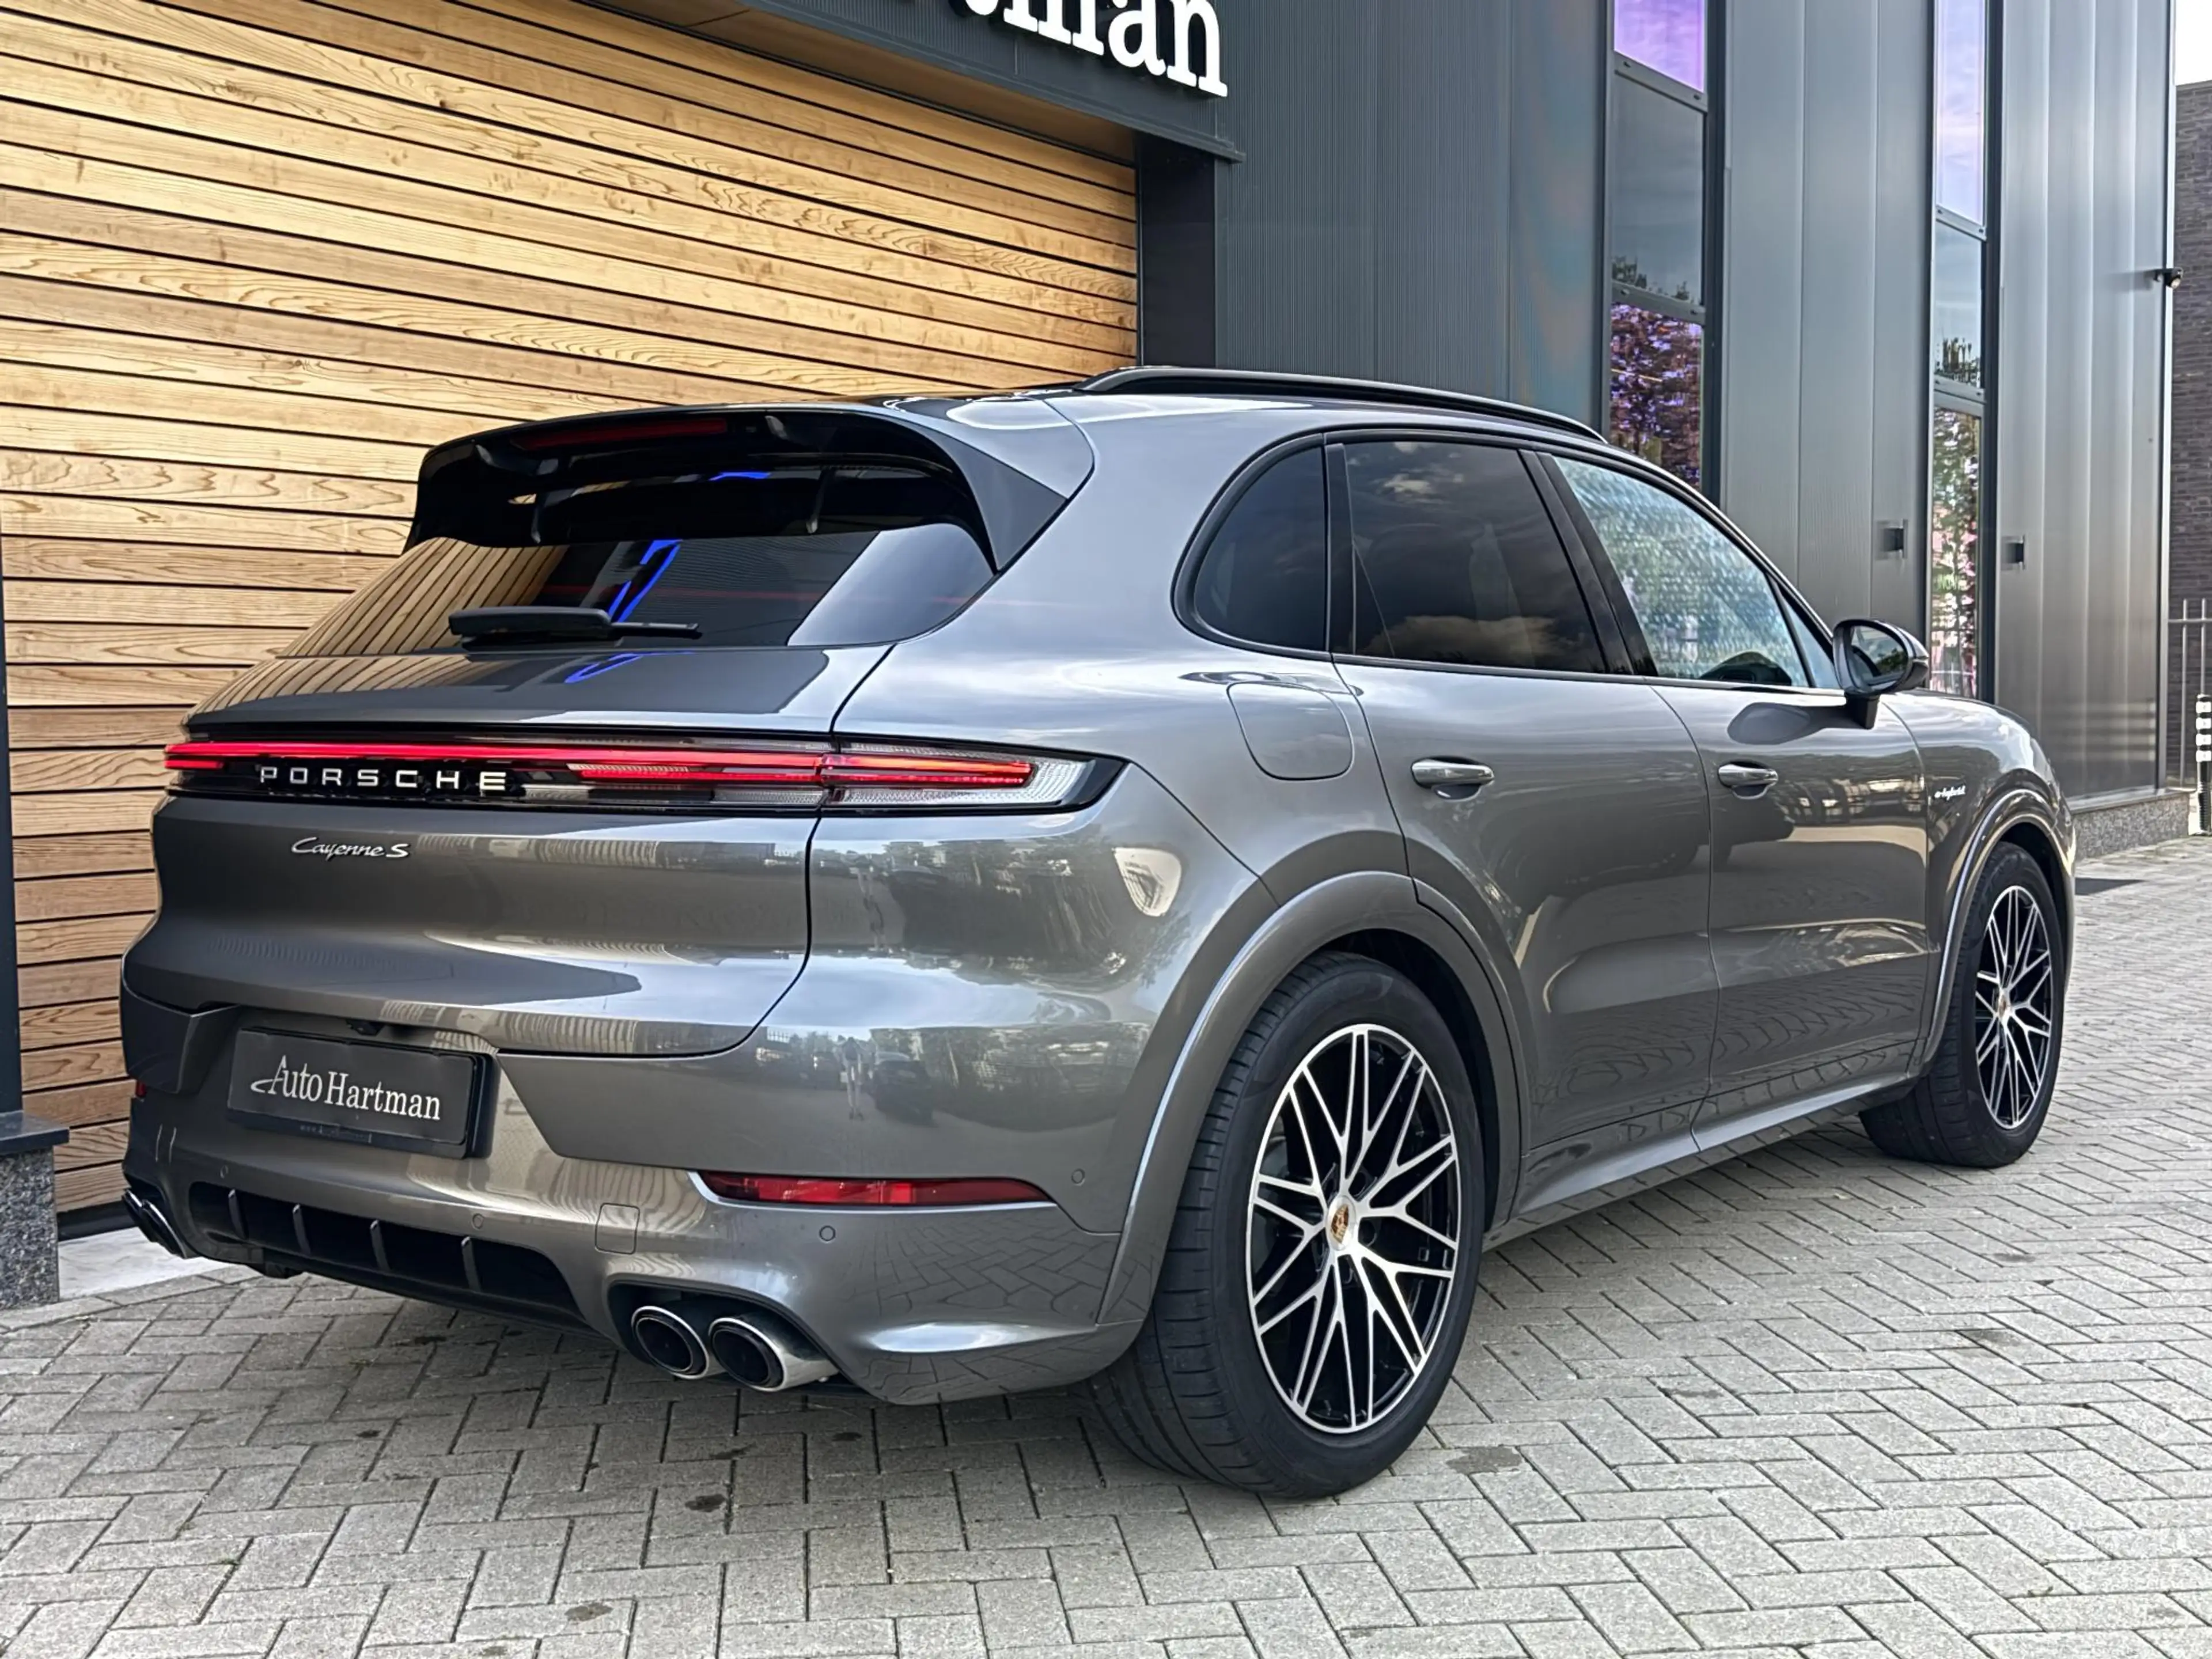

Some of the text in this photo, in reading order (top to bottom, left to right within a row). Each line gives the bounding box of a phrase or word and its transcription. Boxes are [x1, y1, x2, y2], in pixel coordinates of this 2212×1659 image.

[260, 766, 507, 791] PORSCHE
[291, 836, 410, 861] Cayenne S
[250, 1055, 441, 1120] Auto Hartman
